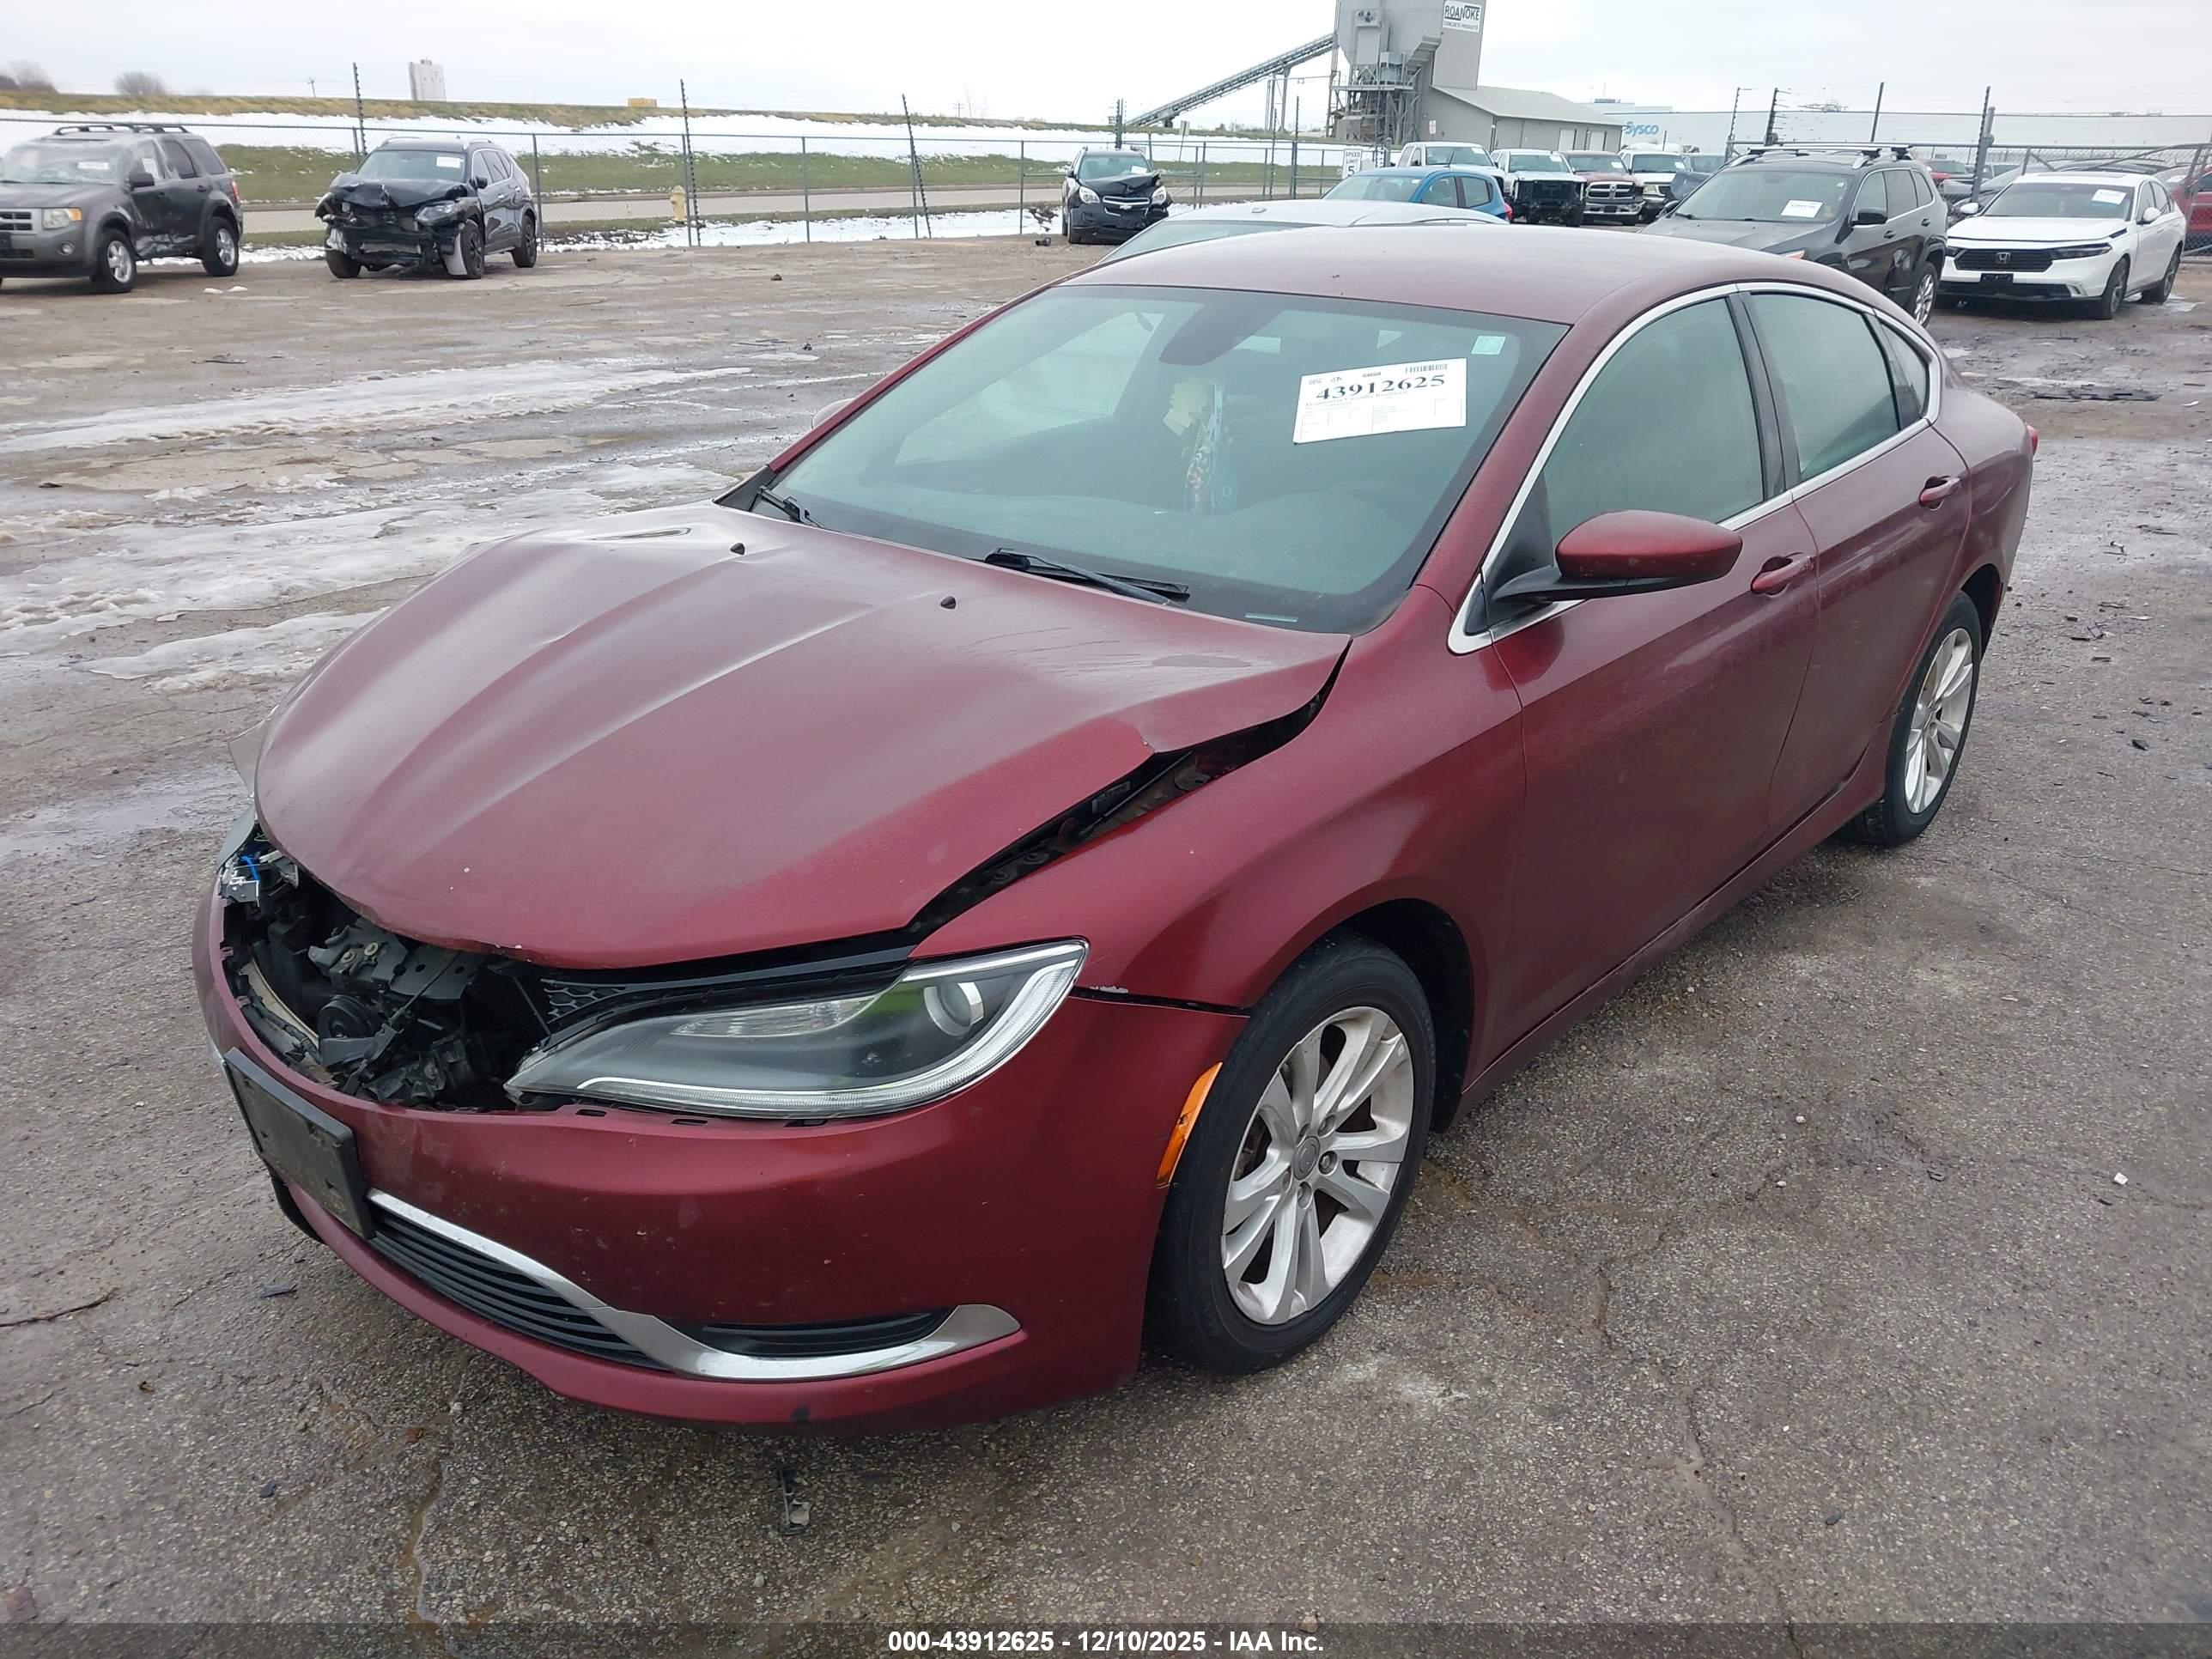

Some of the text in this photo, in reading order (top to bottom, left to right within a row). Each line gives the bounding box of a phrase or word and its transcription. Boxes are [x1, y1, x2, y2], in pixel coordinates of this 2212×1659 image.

[1444, 5, 1480, 21] ROANOKE
[1625, 121, 1659, 137] Sysco
[1347, 166, 1355, 177] 5
[1316, 374, 1445, 400] 43912625
